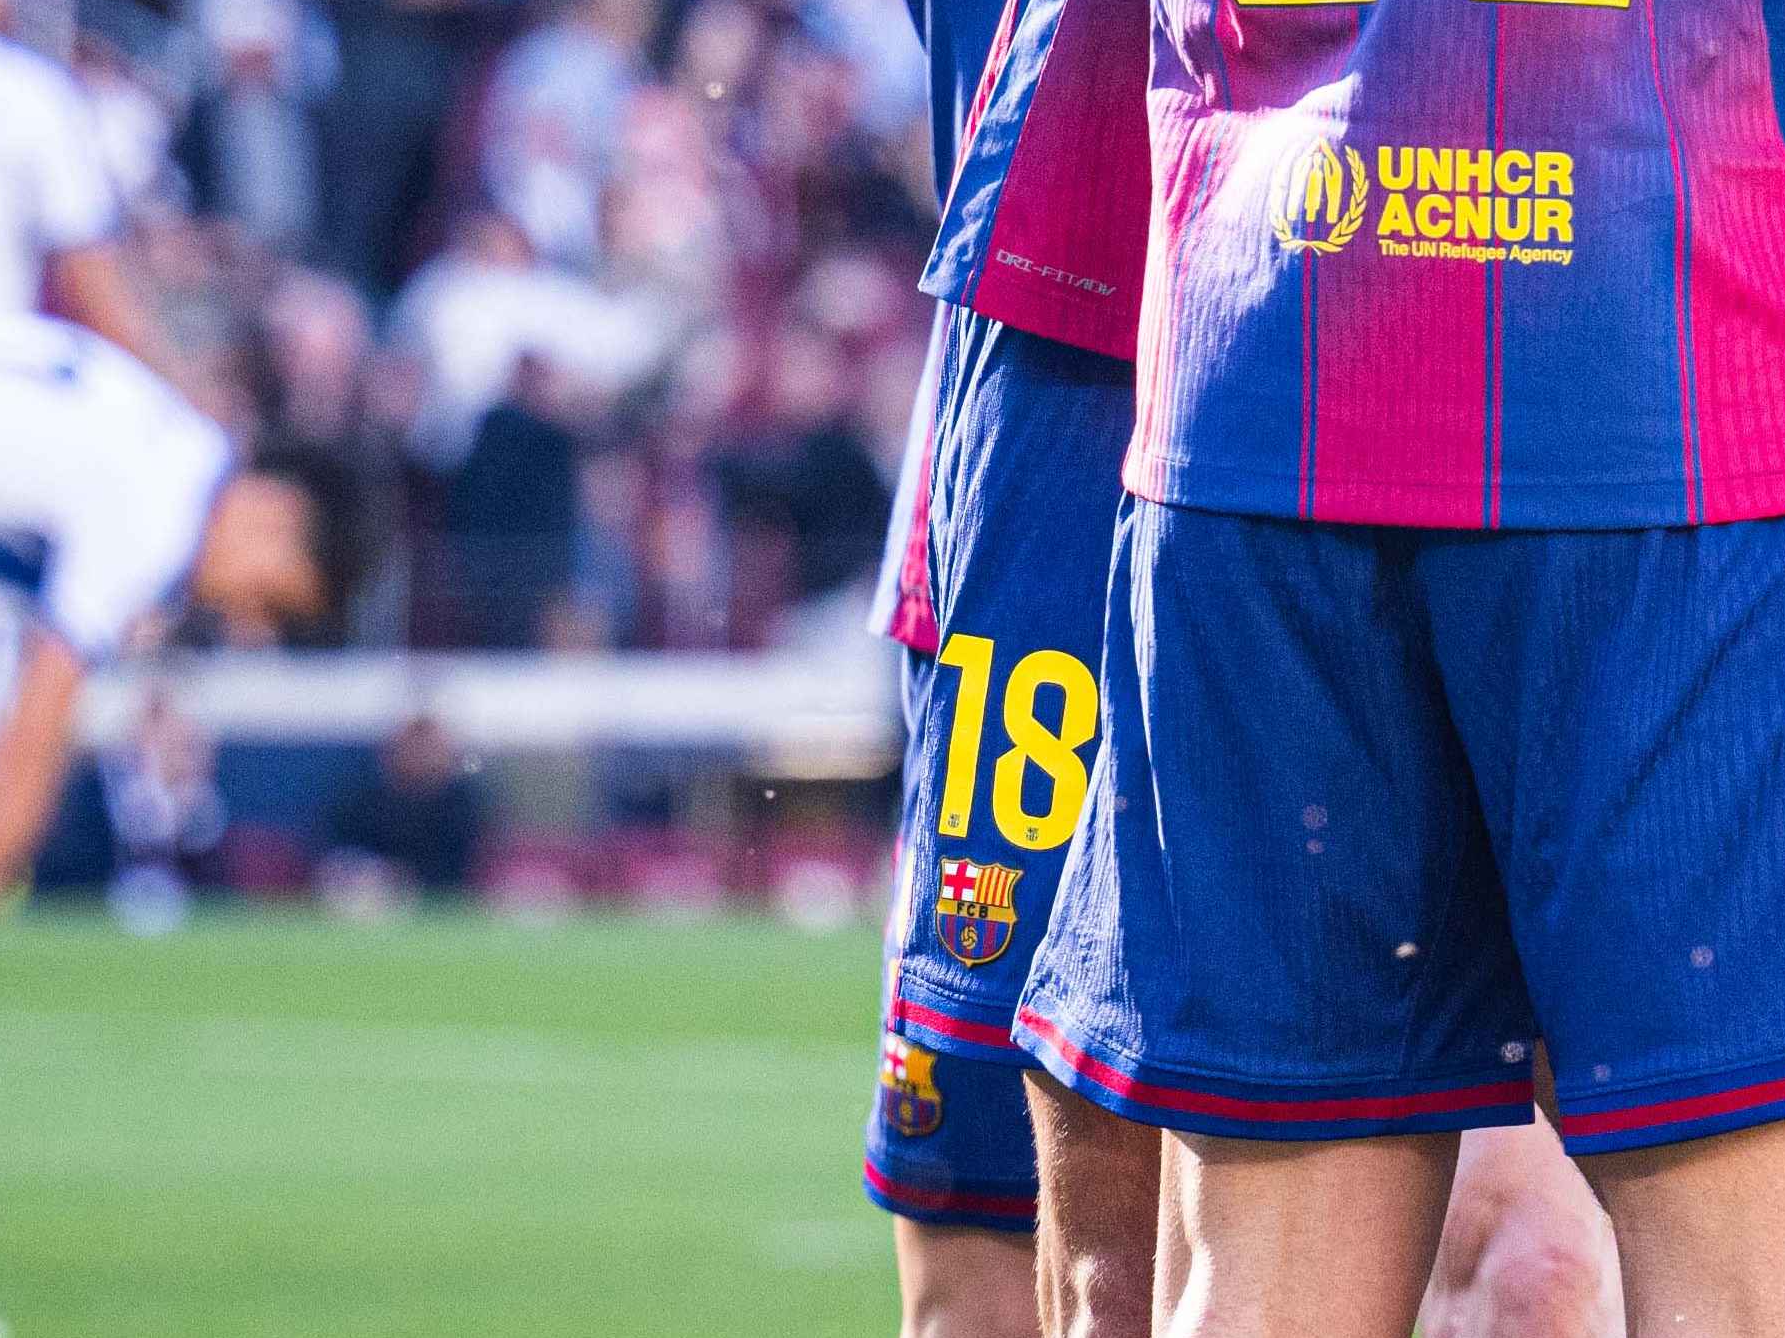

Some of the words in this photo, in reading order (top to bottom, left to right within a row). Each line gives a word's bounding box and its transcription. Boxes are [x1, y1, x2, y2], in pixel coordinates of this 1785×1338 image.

[1378, 145, 1575, 196] UNHCR
[1377, 192, 1575, 243] ACNUR
[1379, 238, 1409, 257] The
[1412, 241, 1438, 257] UN
[1439, 242, 1508, 264] Refugee
[1509, 244, 1574, 266] Agency
[937, 632, 1099, 851] 18
[956, 901, 989, 919] FCB
